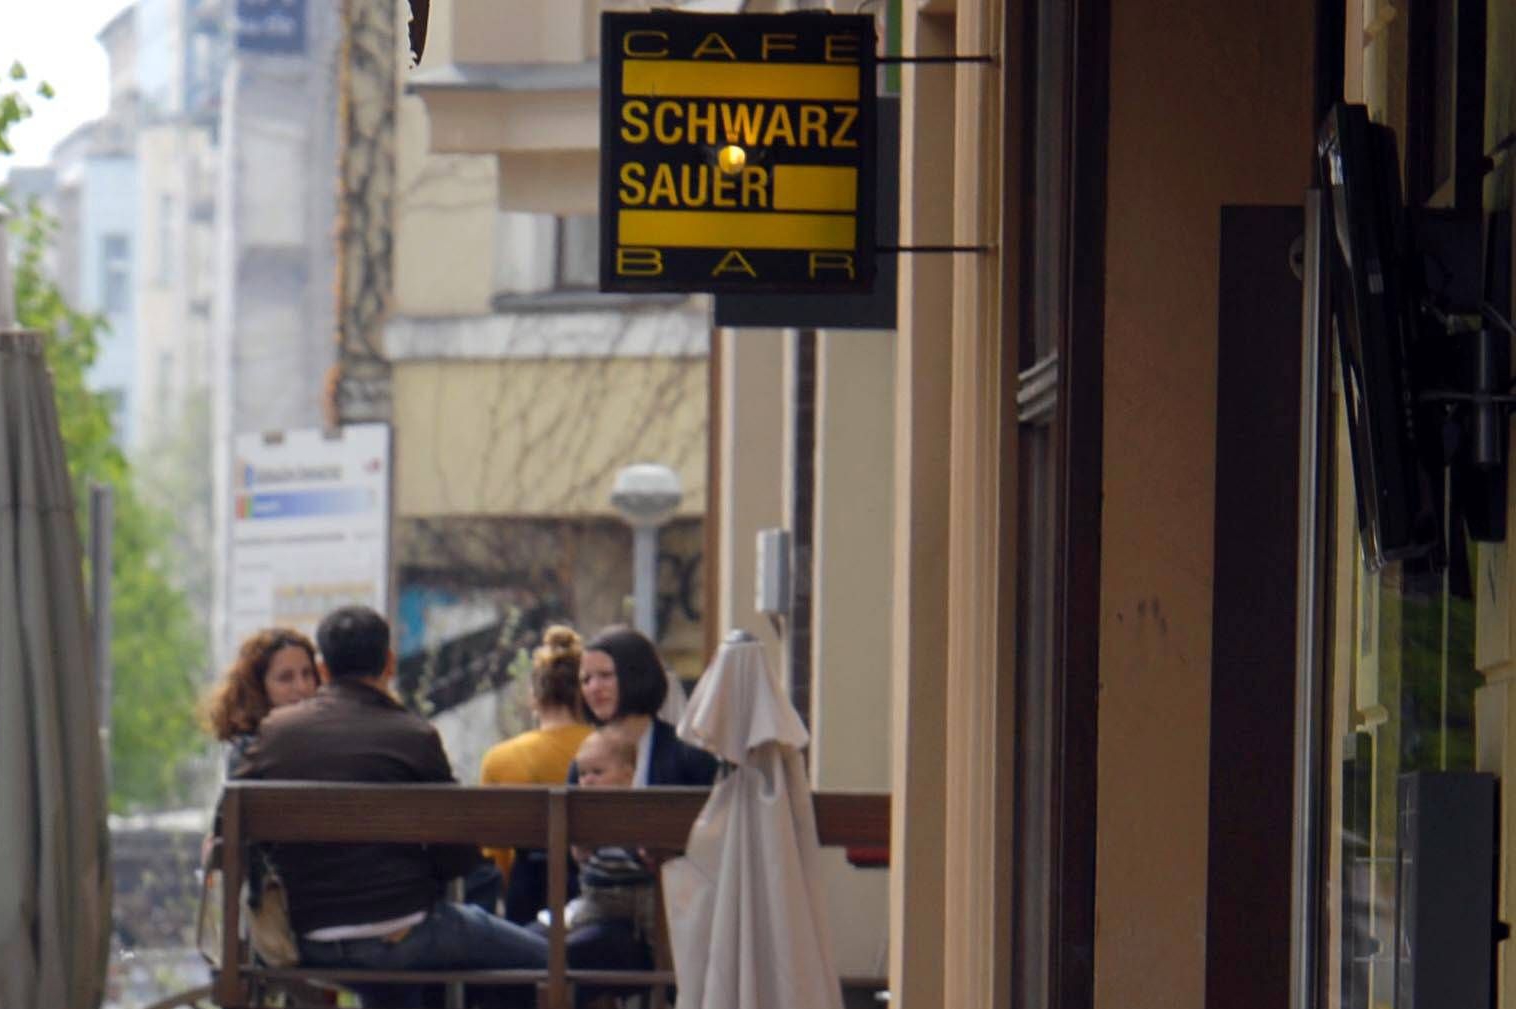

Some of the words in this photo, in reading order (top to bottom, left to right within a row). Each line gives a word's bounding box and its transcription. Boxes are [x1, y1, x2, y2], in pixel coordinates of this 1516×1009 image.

[623, 30, 860, 62] CAFE
[620, 100, 859, 148] SCHWARZ
[618, 162, 768, 208] SAUER
[615, 248, 855, 279] BAR
